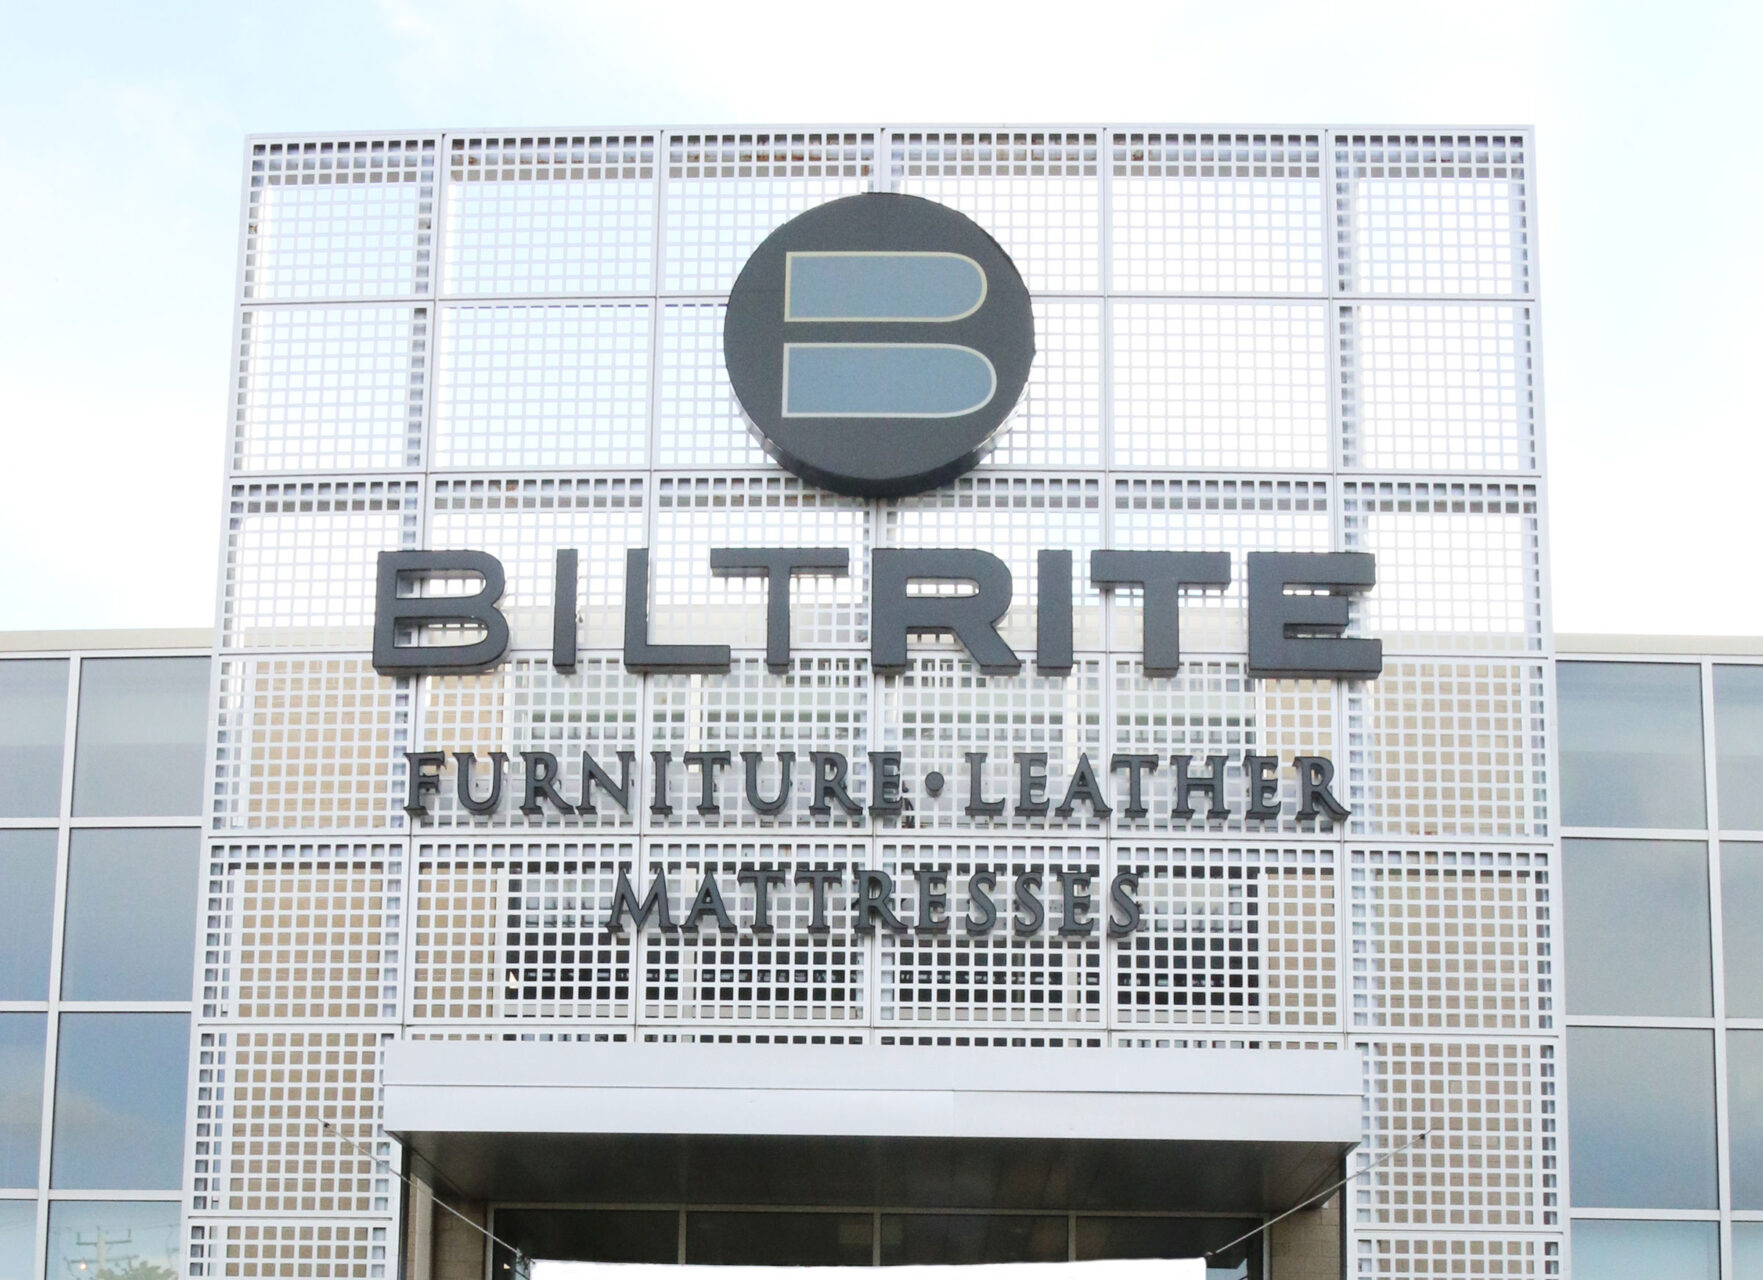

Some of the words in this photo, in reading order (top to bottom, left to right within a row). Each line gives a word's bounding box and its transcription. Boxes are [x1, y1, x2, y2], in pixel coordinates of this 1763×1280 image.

[372, 547, 1383, 680] BILTRITE
[403, 751, 903, 817] FURNITURE
[964, 752, 1351, 822] LEATHER
[605, 865, 1144, 938] MATTRESSES
